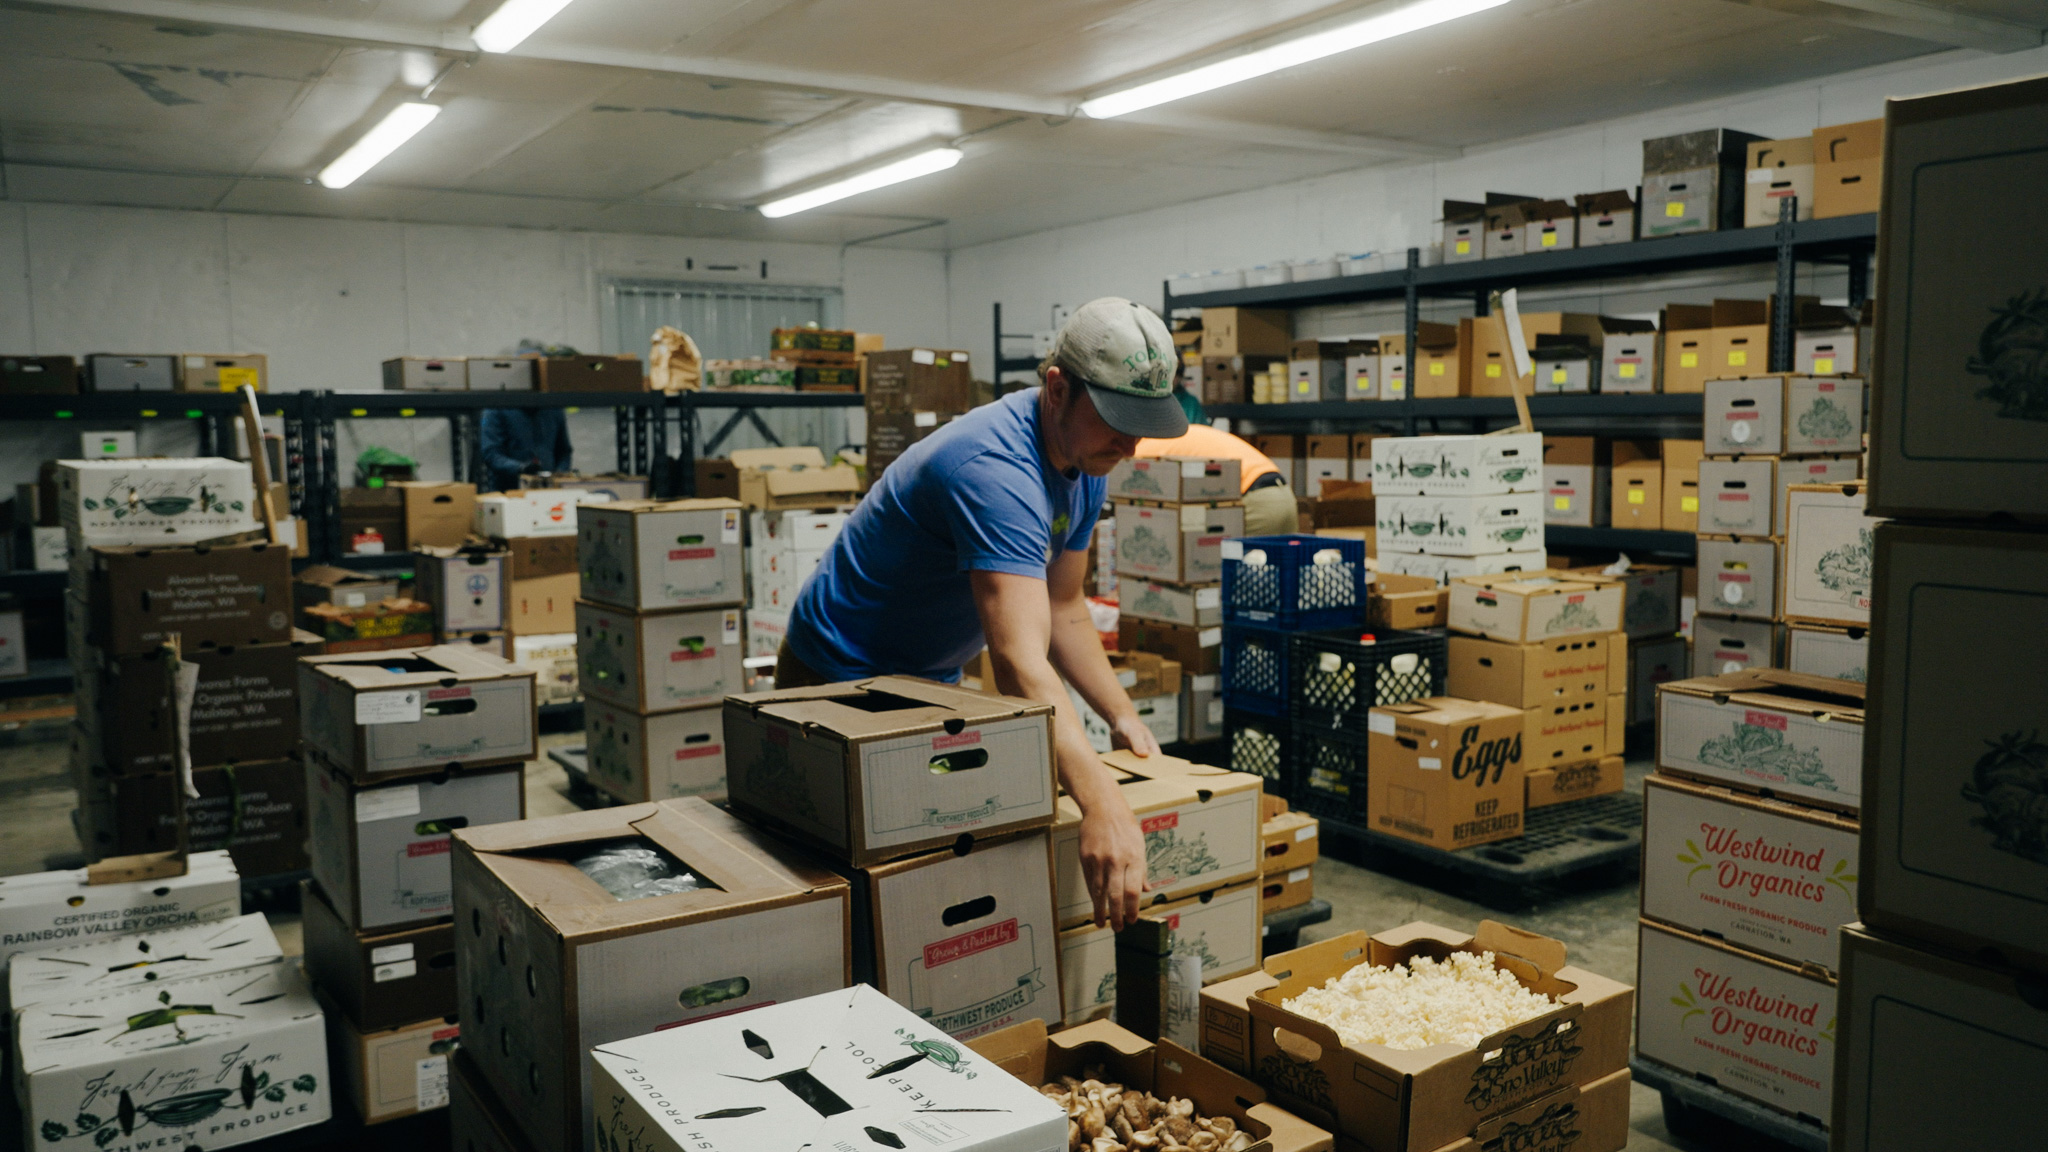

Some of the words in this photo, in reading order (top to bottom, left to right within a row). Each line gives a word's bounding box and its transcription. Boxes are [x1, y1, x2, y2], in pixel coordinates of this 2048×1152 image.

[168, 576, 207, 586] Alvarez
[177, 586, 217, 599] Organic
[217, 596, 237, 607] WA
[246, 687, 293, 699] Produce
[1452, 724, 1523, 788] Eggs
[239, 792, 269, 802] arms
[246, 801, 293, 814] Produce
[1475, 798, 1499, 818] KEEP
[1453, 812, 1520, 842] REFRIGERATED
[1700, 822, 1825, 873] Westwind
[1717, 859, 1826, 903] Organics
[2, 926, 81, 946] RAINBOW
[84, 919, 141, 935] VALLEY
[143, 910, 200, 928] ORCHA
[54, 909, 120, 926] CERTIFIED
[122, 902, 181, 917] ORGANIC
[1700, 893, 1721, 905] FARM
[1722, 899, 1748, 913] FRESH
[1749, 907, 1786, 924] ORGANIC
[1787, 918, 1828, 936] PRODUCE
[1779, 935, 1792, 944] WA
[930, 1007, 982, 1032] NORTHWEST
[984, 990, 1025, 1018] PRODUCE
[1694, 967, 1820, 1027] Westwind
[1711, 1006, 1819, 1057] Organics
[1491, 1076, 1522, 1098] Sno
[1522, 1058, 1563, 1086] Valley
[1694, 1037, 1715, 1051] FARM
[1715, 1045, 1742, 1060] FRESH
[1742, 1055, 1779, 1074] ORGANIC
[1780, 1069, 1821, 1090] PRODUCE
[625, 1068, 690, 1126] PRODUCE
[888, 1075, 937, 1109] KEEP
[210, 1103, 309, 1135] PRODUCE
